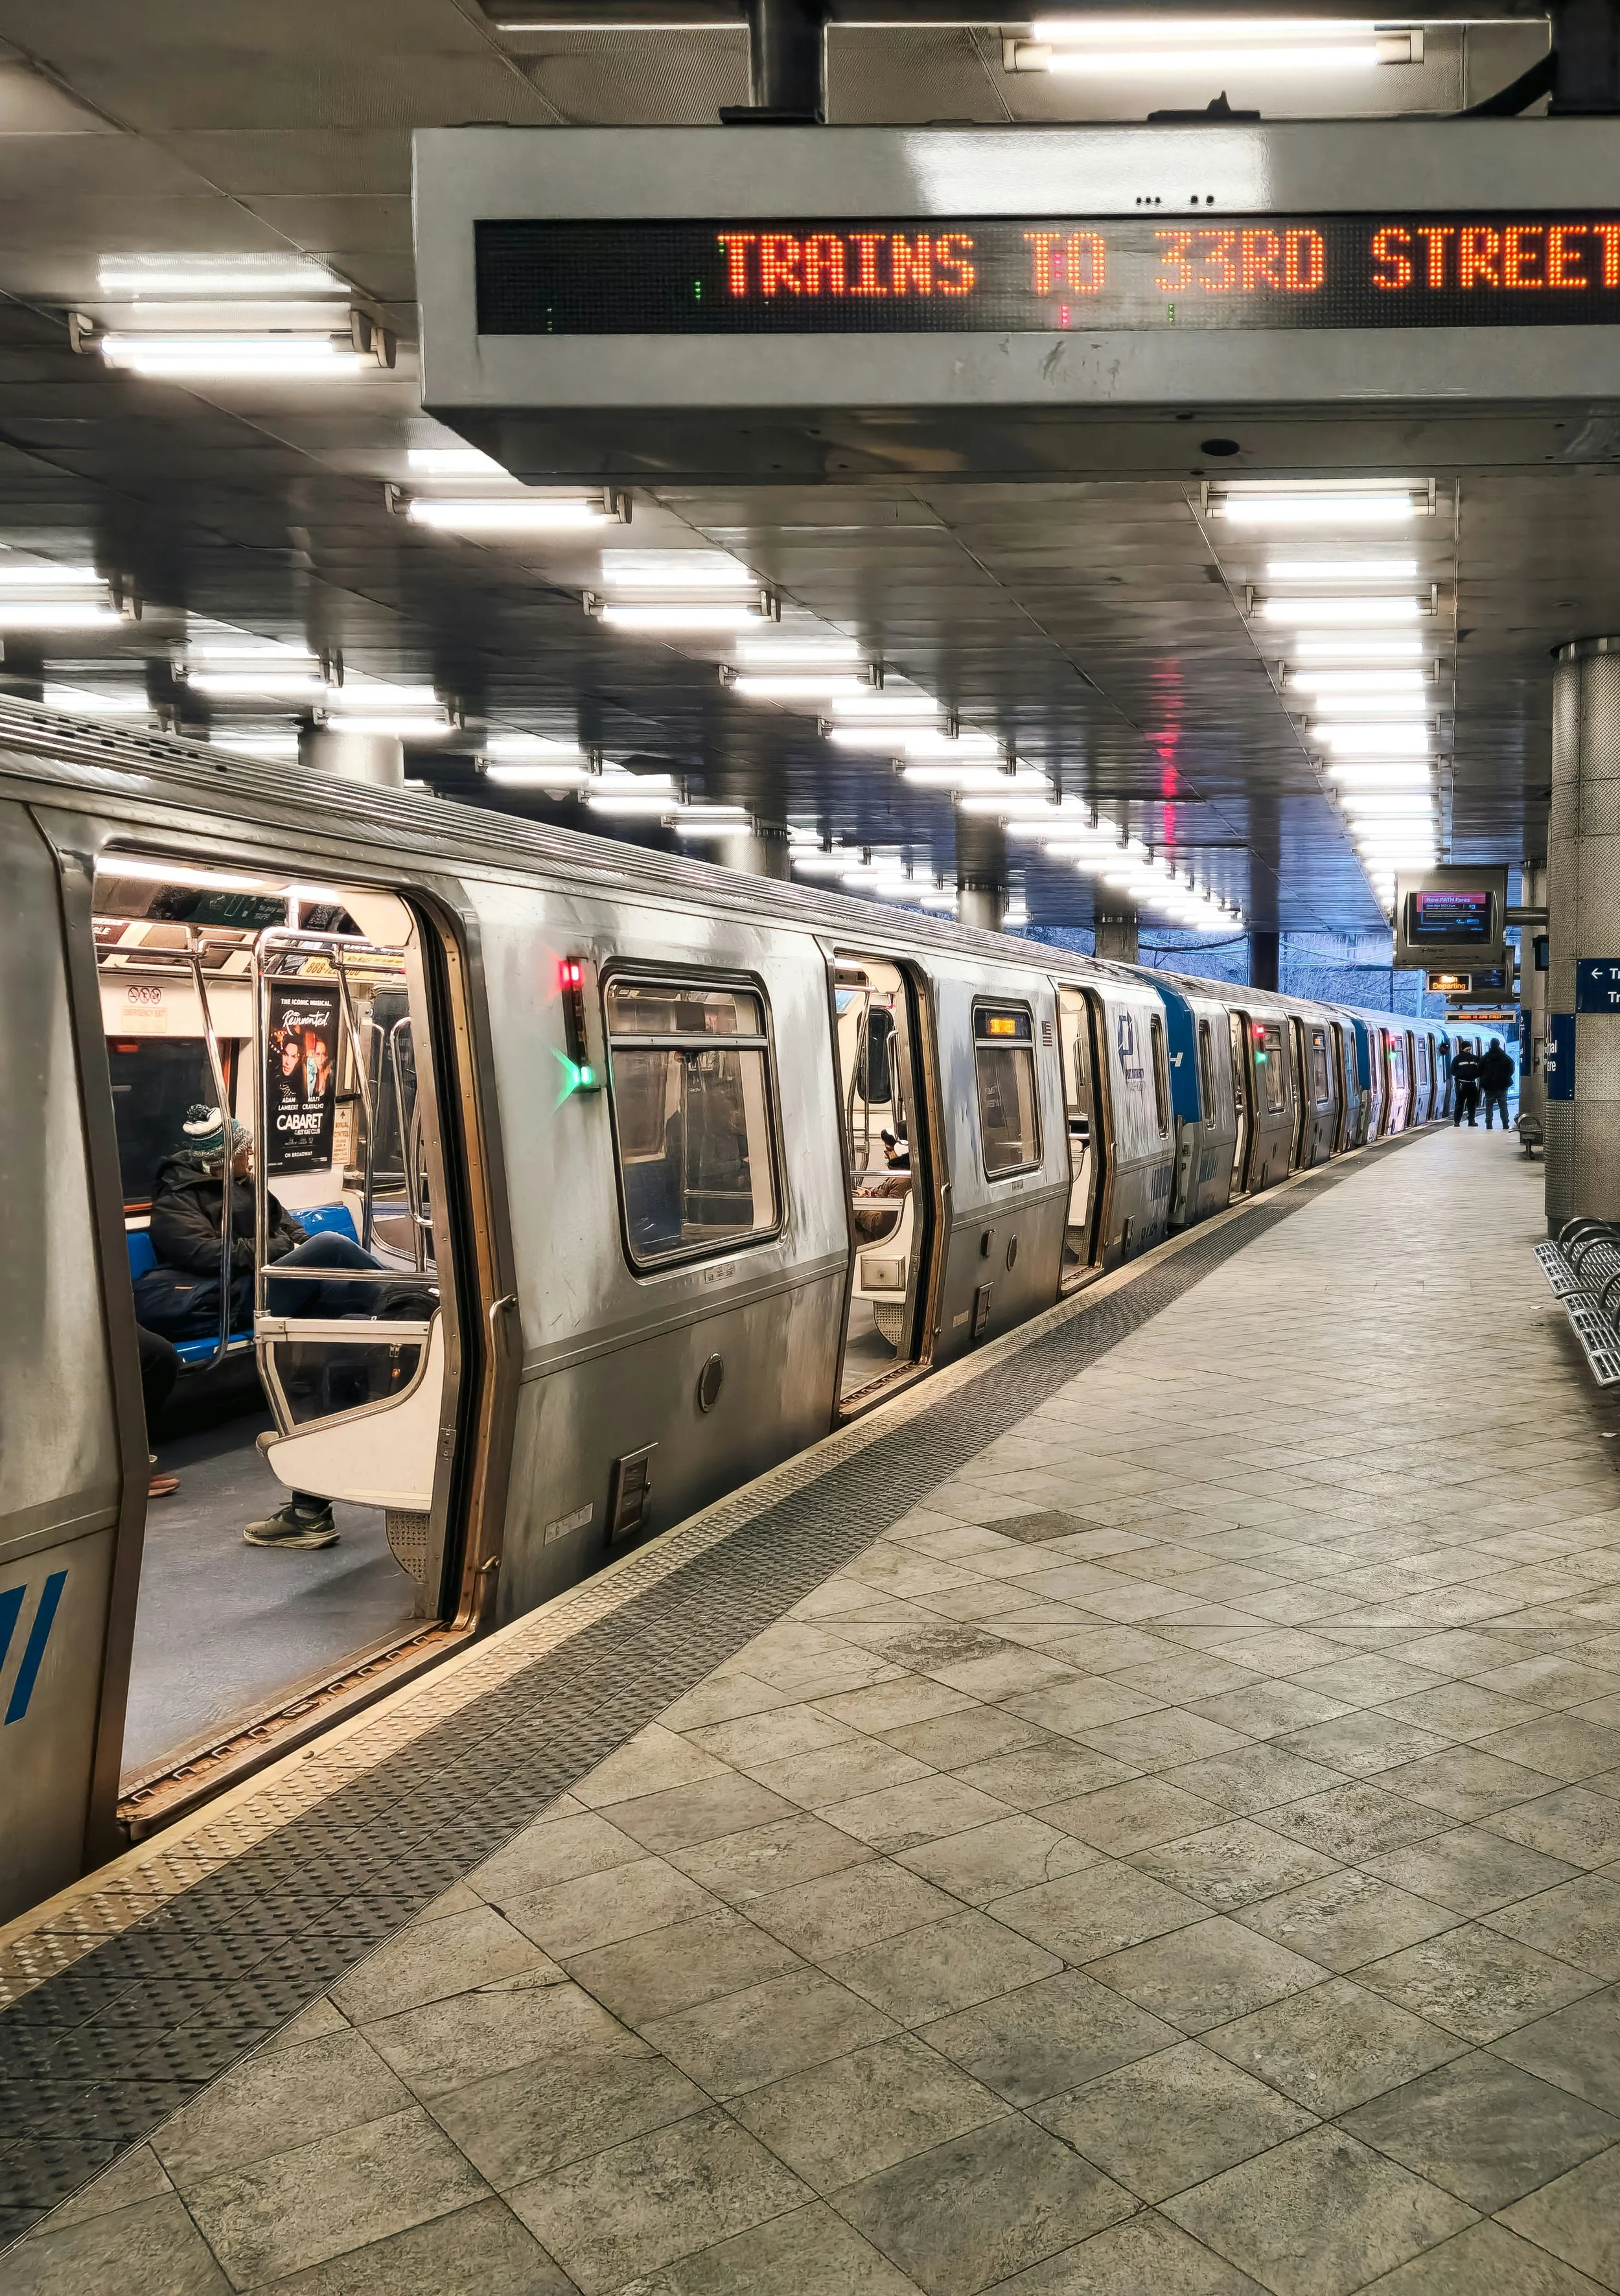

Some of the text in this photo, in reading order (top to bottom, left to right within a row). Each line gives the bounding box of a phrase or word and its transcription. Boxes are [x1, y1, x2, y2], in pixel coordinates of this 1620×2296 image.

[718, 226, 1620, 297] TRAINS TO 33RD STREET
[277, 1113, 323, 1131] CABARET
